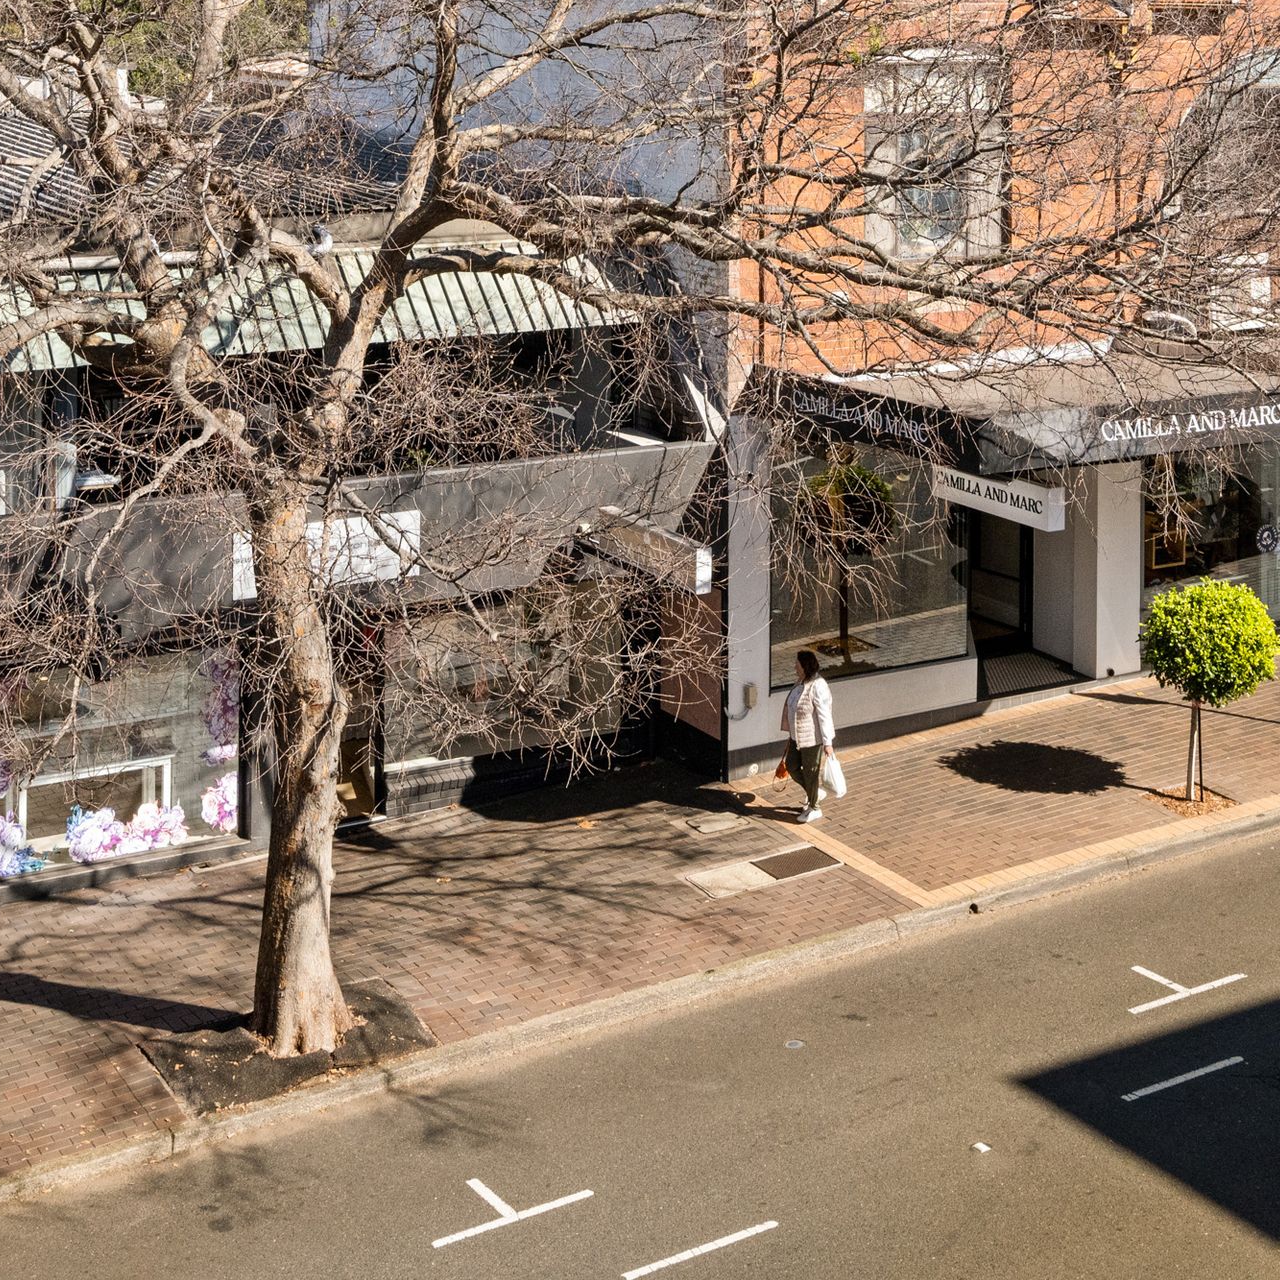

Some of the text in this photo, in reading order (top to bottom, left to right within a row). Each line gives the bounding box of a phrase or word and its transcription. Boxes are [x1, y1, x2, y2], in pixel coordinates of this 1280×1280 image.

[792, 389, 851, 422] CAMILLA
[884, 413, 929, 443] MARC
[1101, 414, 1181, 442] CAMILLA
[1186, 410, 1225, 434] AND
[937, 470, 1044, 515] CAMILLA AND MARC
